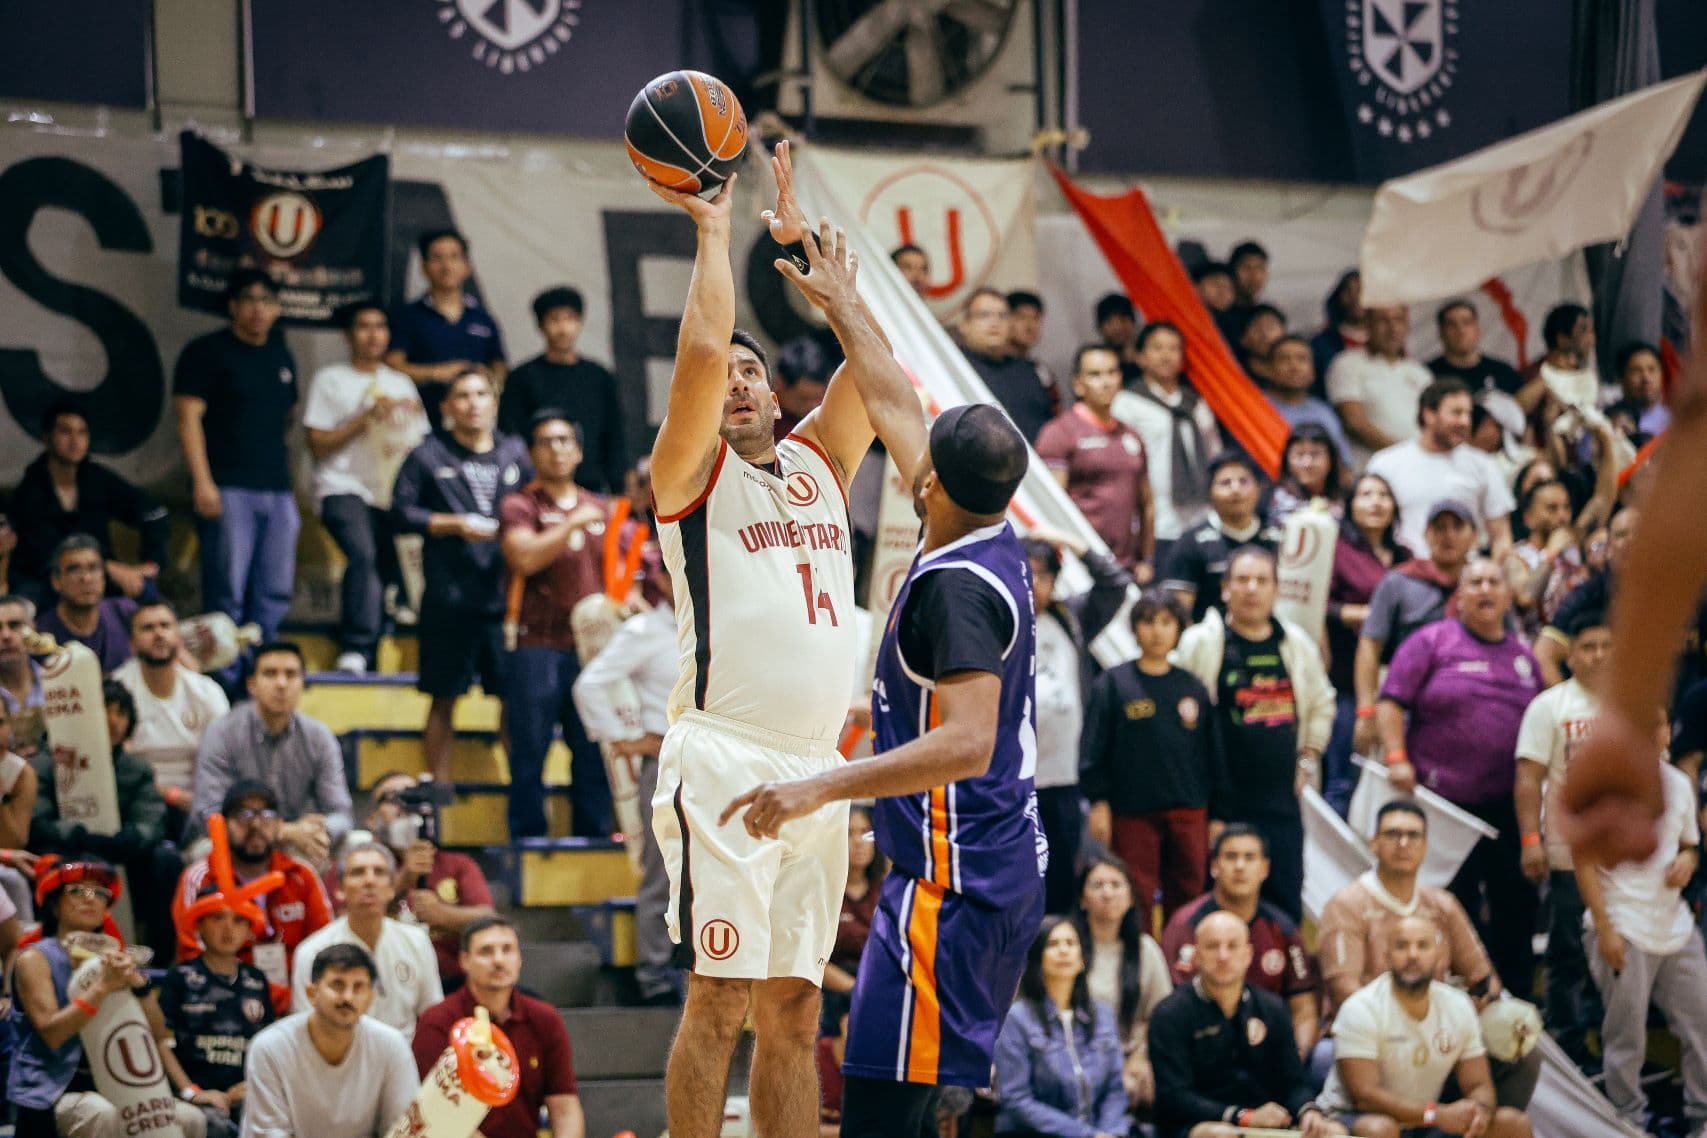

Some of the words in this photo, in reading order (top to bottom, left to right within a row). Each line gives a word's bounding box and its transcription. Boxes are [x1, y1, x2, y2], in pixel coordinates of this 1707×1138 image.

[895, 207, 966, 299] U
[795, 563, 839, 628] 14
[708, 926, 730, 956] U
